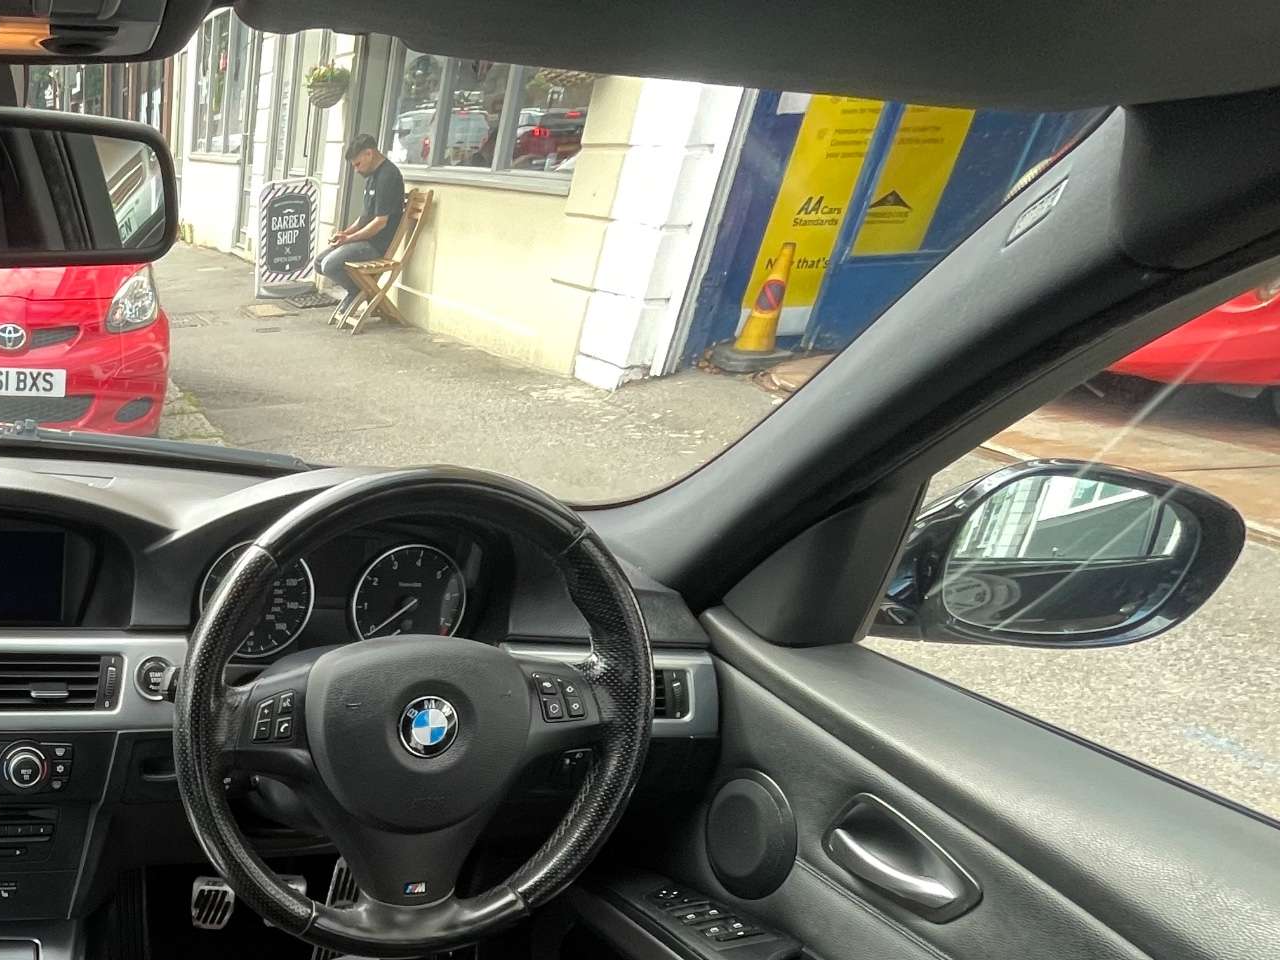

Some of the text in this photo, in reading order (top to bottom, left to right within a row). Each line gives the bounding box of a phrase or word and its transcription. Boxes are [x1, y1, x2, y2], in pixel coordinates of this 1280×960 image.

[796, 195, 842, 215] AA Cars
[271, 213, 306, 231] BARBER
[792, 217, 839, 227] Standards
[277, 230, 299, 245] SHOP
[15, 370, 54, 393] BXS
[407, 699, 452, 719] BMW
